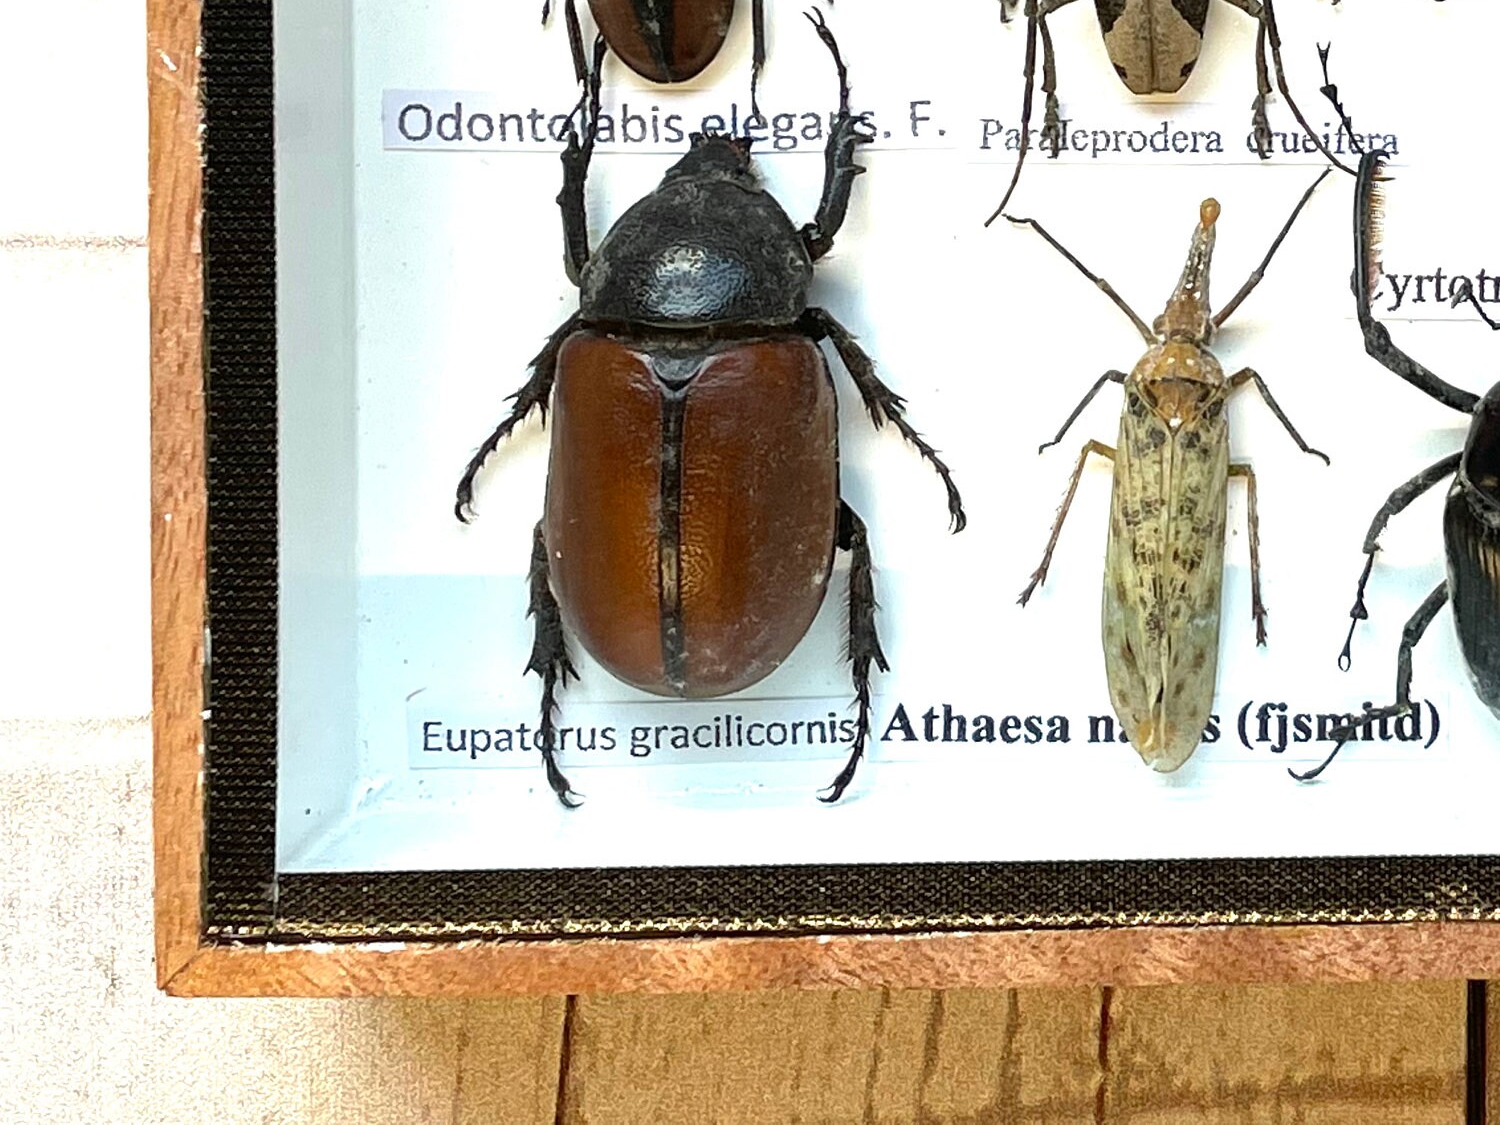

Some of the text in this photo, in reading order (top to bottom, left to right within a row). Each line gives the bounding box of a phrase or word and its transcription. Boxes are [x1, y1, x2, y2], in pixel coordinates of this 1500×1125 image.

[701, 103, 892, 151] elegas.
[910, 100, 947, 137] F.
[423, 711, 857, 760] Eupatorus gracilicornis
[880, 704, 1071, 743] Athaesa
